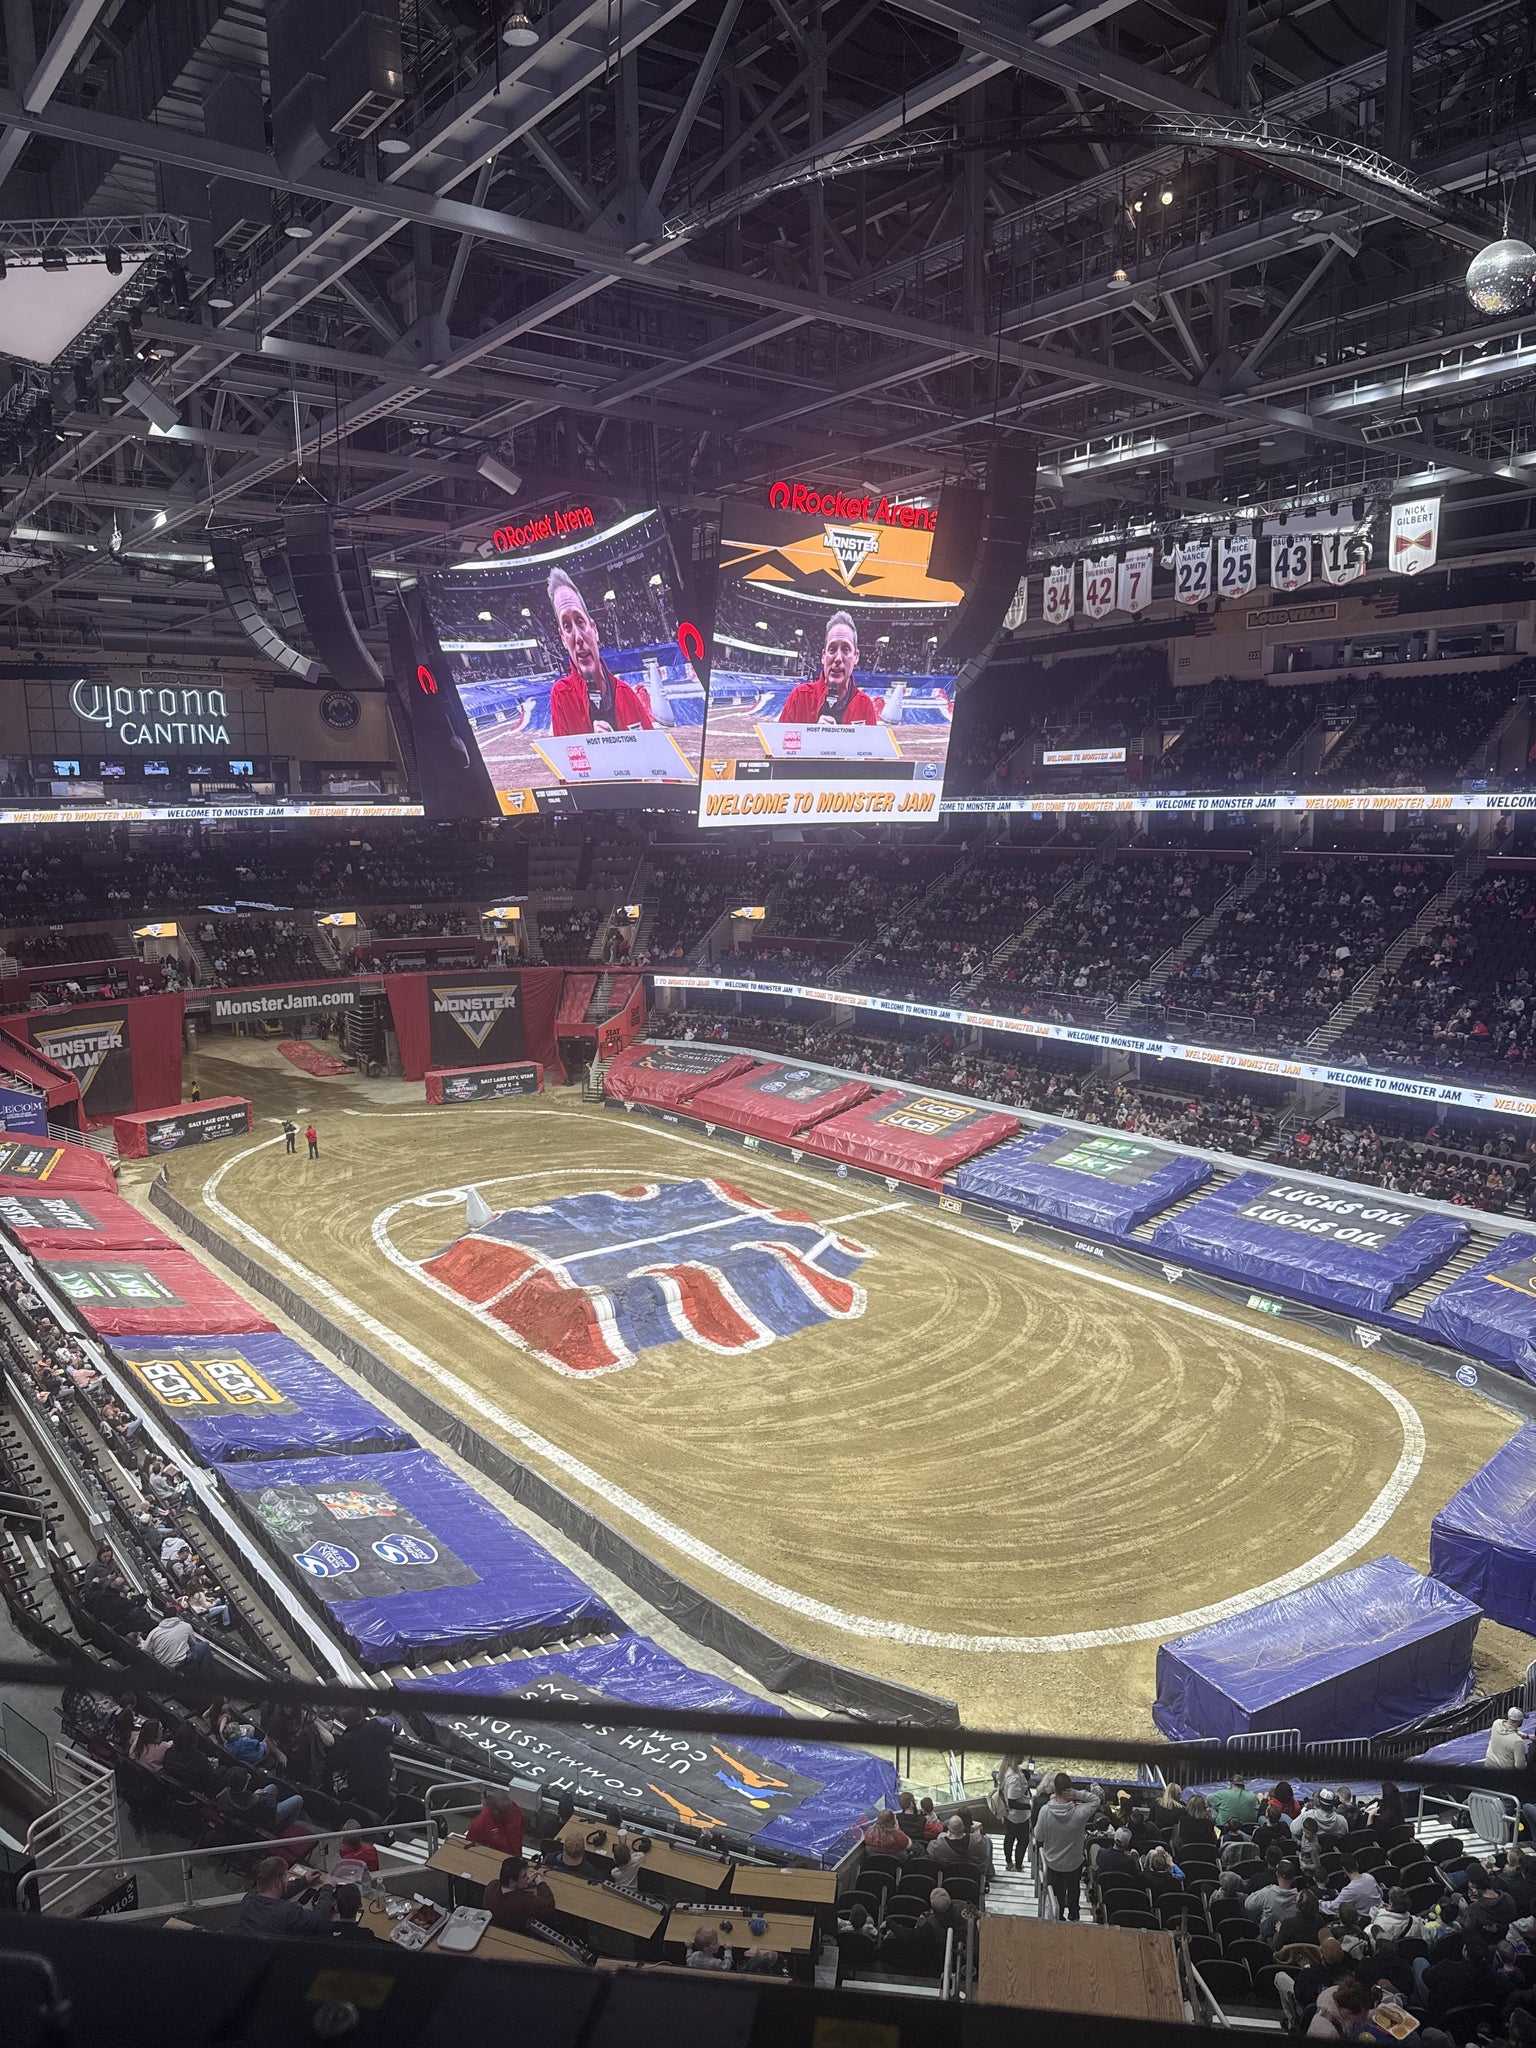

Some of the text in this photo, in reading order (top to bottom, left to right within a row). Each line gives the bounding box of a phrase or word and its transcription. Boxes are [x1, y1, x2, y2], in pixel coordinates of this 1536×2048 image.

[792, 483, 872, 521] Rocket
[1405, 505, 1426, 515] NICK
[504, 506, 594, 548] Rocket Arena
[1397, 513, 1433, 526] GILBERT
[824, 535, 879, 553] MONSTER
[1227, 543, 1248, 554] PRICE
[837, 549, 864, 563] JAM
[1182, 552, 1205, 561] NANCE
[1275, 545, 1307, 578] 43
[1085, 567, 1114, 577] THURMOND
[1125, 561, 1146, 571] SMITH
[1222, 553, 1251, 586] 25
[1051, 576, 1067, 584] CARR
[1130, 572, 1141, 599] 7
[1179, 561, 1207, 593] 22
[1047, 584, 1070, 612] 34
[1086, 577, 1112, 606] 42
[70, 678, 230, 728] Corona
[120, 722, 230, 745] CANTINA
[586, 735, 637, 745] HOST PREDICTIONS
[1047, 751, 1122, 762] WELCOME TO MONSTER JAM
[706, 792, 936, 816] WELCOME TO MONSTER JAM
[939, 802, 956, 810] COME
[956, 802, 965, 810] TO
[997, 802, 1011, 810] JAM
[1031, 801, 1133, 811] WELCOME TO MONSTER JAM
[1155, 798, 1276, 809] WELCOME TO MONSTER JAM
[1304, 797, 1453, 809] WELCOME TO MONSTER JAM
[13, 810, 142, 822] WELCOME TO MONSTER JAM
[167, 807, 284, 818] WELCOME TO MONSTER JAM
[308, 807, 421, 817] WELCOME TO MONSTER JAM
[724, 981, 749, 989] WELCOME
[757, 984, 782, 992] MONSTER
[782, 986, 793, 994] JAM
[215, 992, 354, 1016] MonsterJam.com
[434, 997, 516, 1012] MONSTER
[880, 1001, 950, 1018] WELCOME TO MONSTER JAM
[457, 1009, 495, 1023] JAM
[605, 1028, 620, 1036] SEAT
[966, 1015, 1049, 1035] WELCOME TO MONSTER JAM
[1067, 1030, 1163, 1053] WELCOME TO MONSTER JAM
[61, 1052, 99, 1070] JAM
[677, 1053, 727, 1063] COMMISSION
[1184, 1049, 1302, 1075] WELCOME TO MONSTER JAM
[659, 1064, 708, 1074] COMMISSION
[1327, 1070, 1463, 1102] WELCOME TO MONSTER JAM
[913, 1101, 967, 1118] JCB
[888, 1114, 942, 1132] JCB
[744, 1136, 760, 1148] BKT
[1092, 1139, 1150, 1156] BKT
[1056, 1152, 1124, 1172] BKT
[941, 1199, 960, 1211] JCB
[1267, 1186, 1364, 1214] LUCAS
[1241, 1205, 1339, 1233] LUCAS
[1075, 1241, 1104, 1257] LUCAS OIL
[54, 1272, 95, 1298] BKT
[108, 1272, 154, 1298] BKT
[1247, 1295, 1283, 1314] BKT
[141, 1363, 202, 1401] JCB
[205, 1362, 267, 1400] JCB
[449, 1721, 546, 1777] SPORTS
[618, 1734, 691, 1775] UTAH
